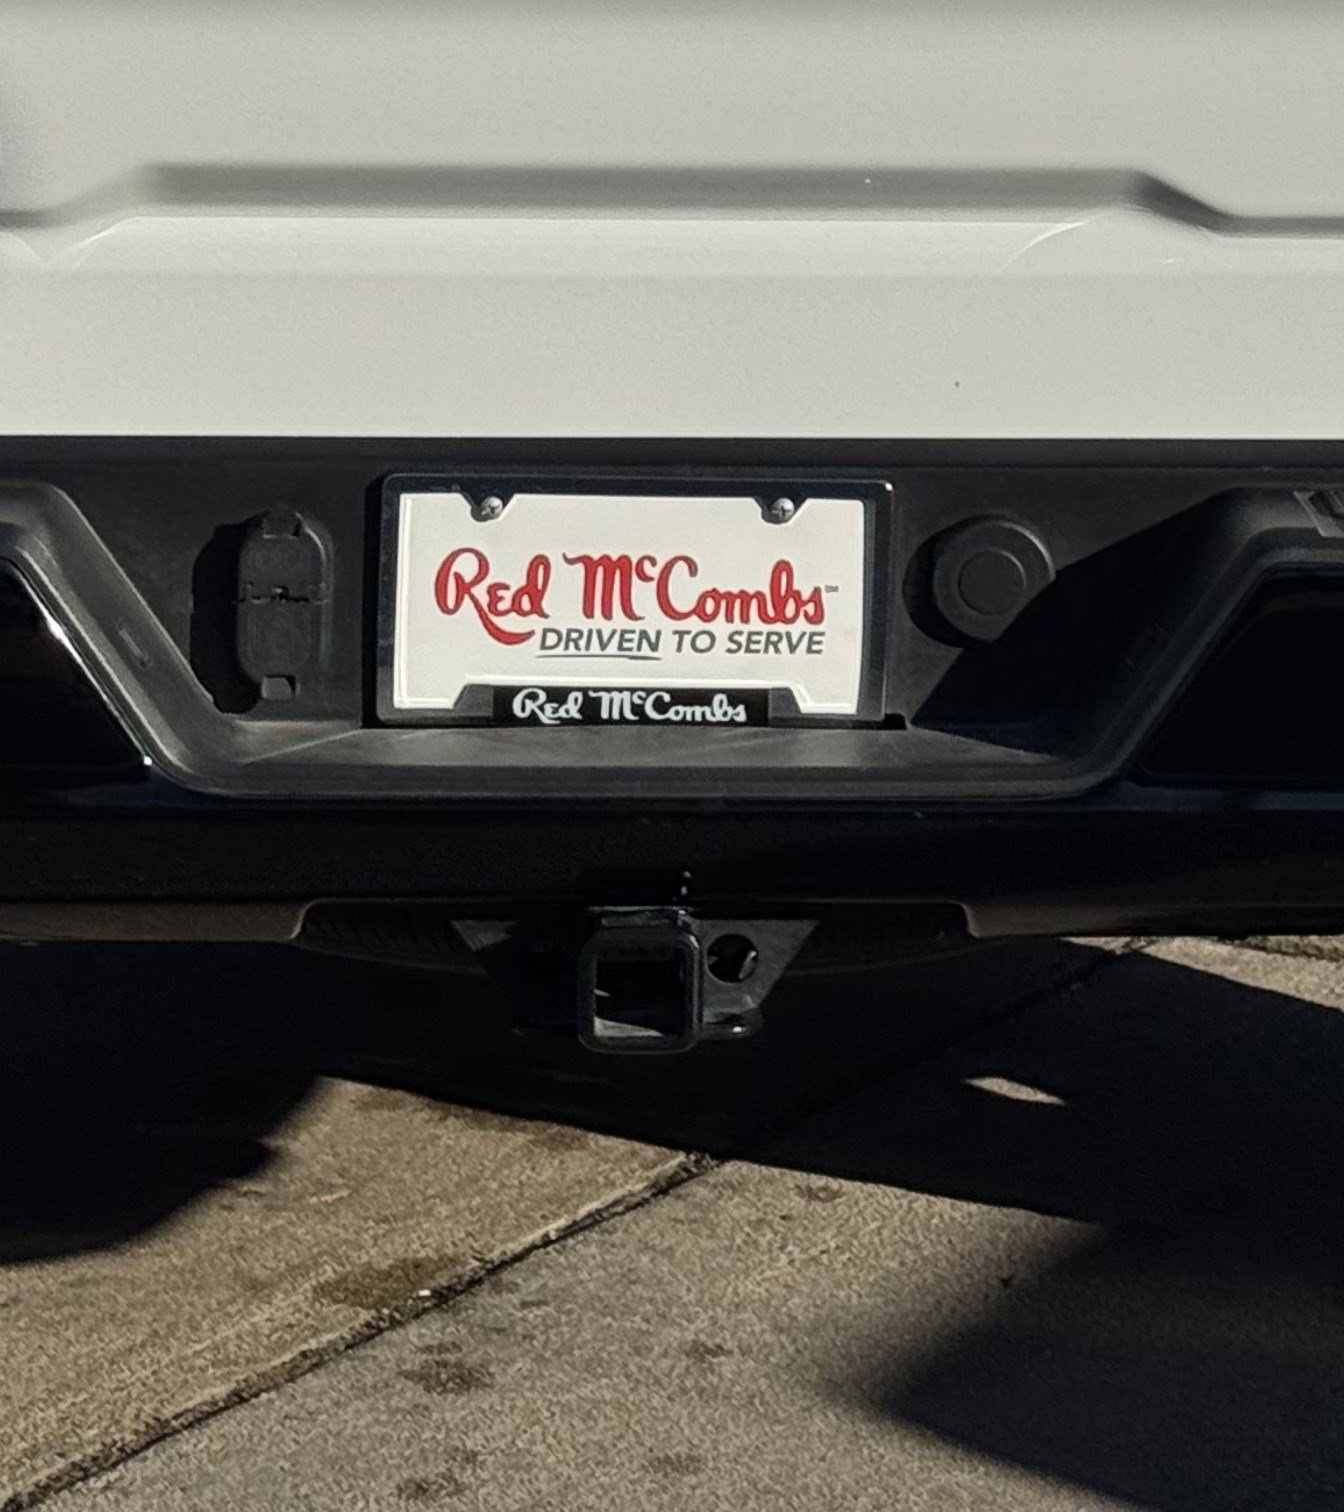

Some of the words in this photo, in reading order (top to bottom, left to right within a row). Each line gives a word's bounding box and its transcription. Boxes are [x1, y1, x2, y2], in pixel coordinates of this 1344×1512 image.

[434, 547, 551, 646] Red
[561, 553, 825, 626] McCombs
[539, 628, 662, 653] DRIVEN
[671, 629, 716, 654] TO
[725, 630, 826, 656] SERVE
[512, 687, 584, 724] Red
[588, 690, 747, 723] McCombs
